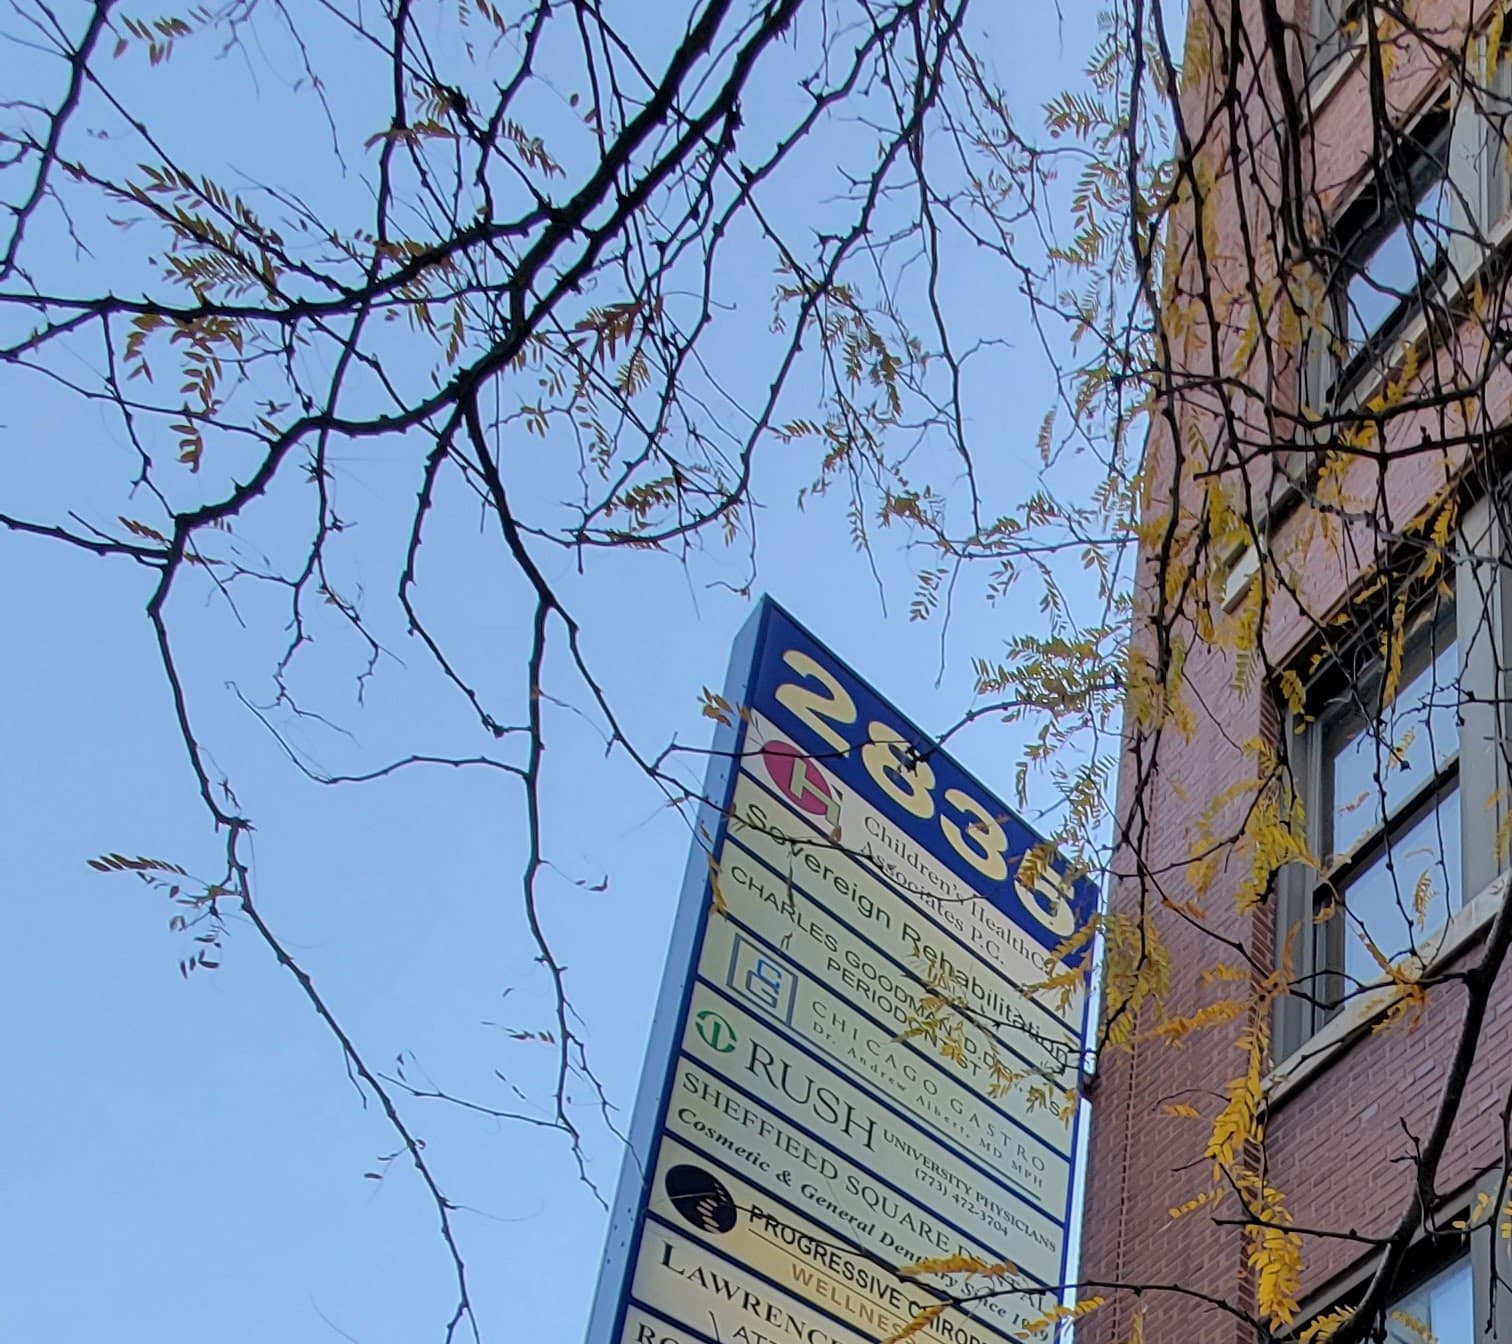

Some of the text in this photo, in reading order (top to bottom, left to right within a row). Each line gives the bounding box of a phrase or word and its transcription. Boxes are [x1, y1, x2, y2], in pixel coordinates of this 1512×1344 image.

[746, 803, 891, 928] Sovereign
[775, 649, 1075, 937] 2835
[731, 866, 838, 953] CHARLES
[845, 950, 952, 1037] GOODMAN
[864, 816, 1068, 985] Children's HealthC
[970, 926, 1005, 965] P.C.
[682, 1072, 838, 1180] SHEFFIELD
[845, 1175, 950, 1254] SQUARE
[745, 1038, 1056, 1252] RUSH UNIVERSITY PHYSICIANS
[812, 1001, 1045, 1172] CHICAGO GASTRO
[813, 1022, 836, 1045] Dr.
[848, 1047, 906, 1092] Andrew
[979, 1137, 1002, 1159] MD
[1011, 1160, 1043, 1188] MPH
[678, 1108, 770, 1173] Cosmetic
[776, 1168, 793, 1187] &
[800, 1183, 876, 1237] General
[880, 1232, 958, 1288] Dentry
[750, 1204, 902, 1309] PROGRESSIVE
[915, 1167, 948, 1197] (773)
